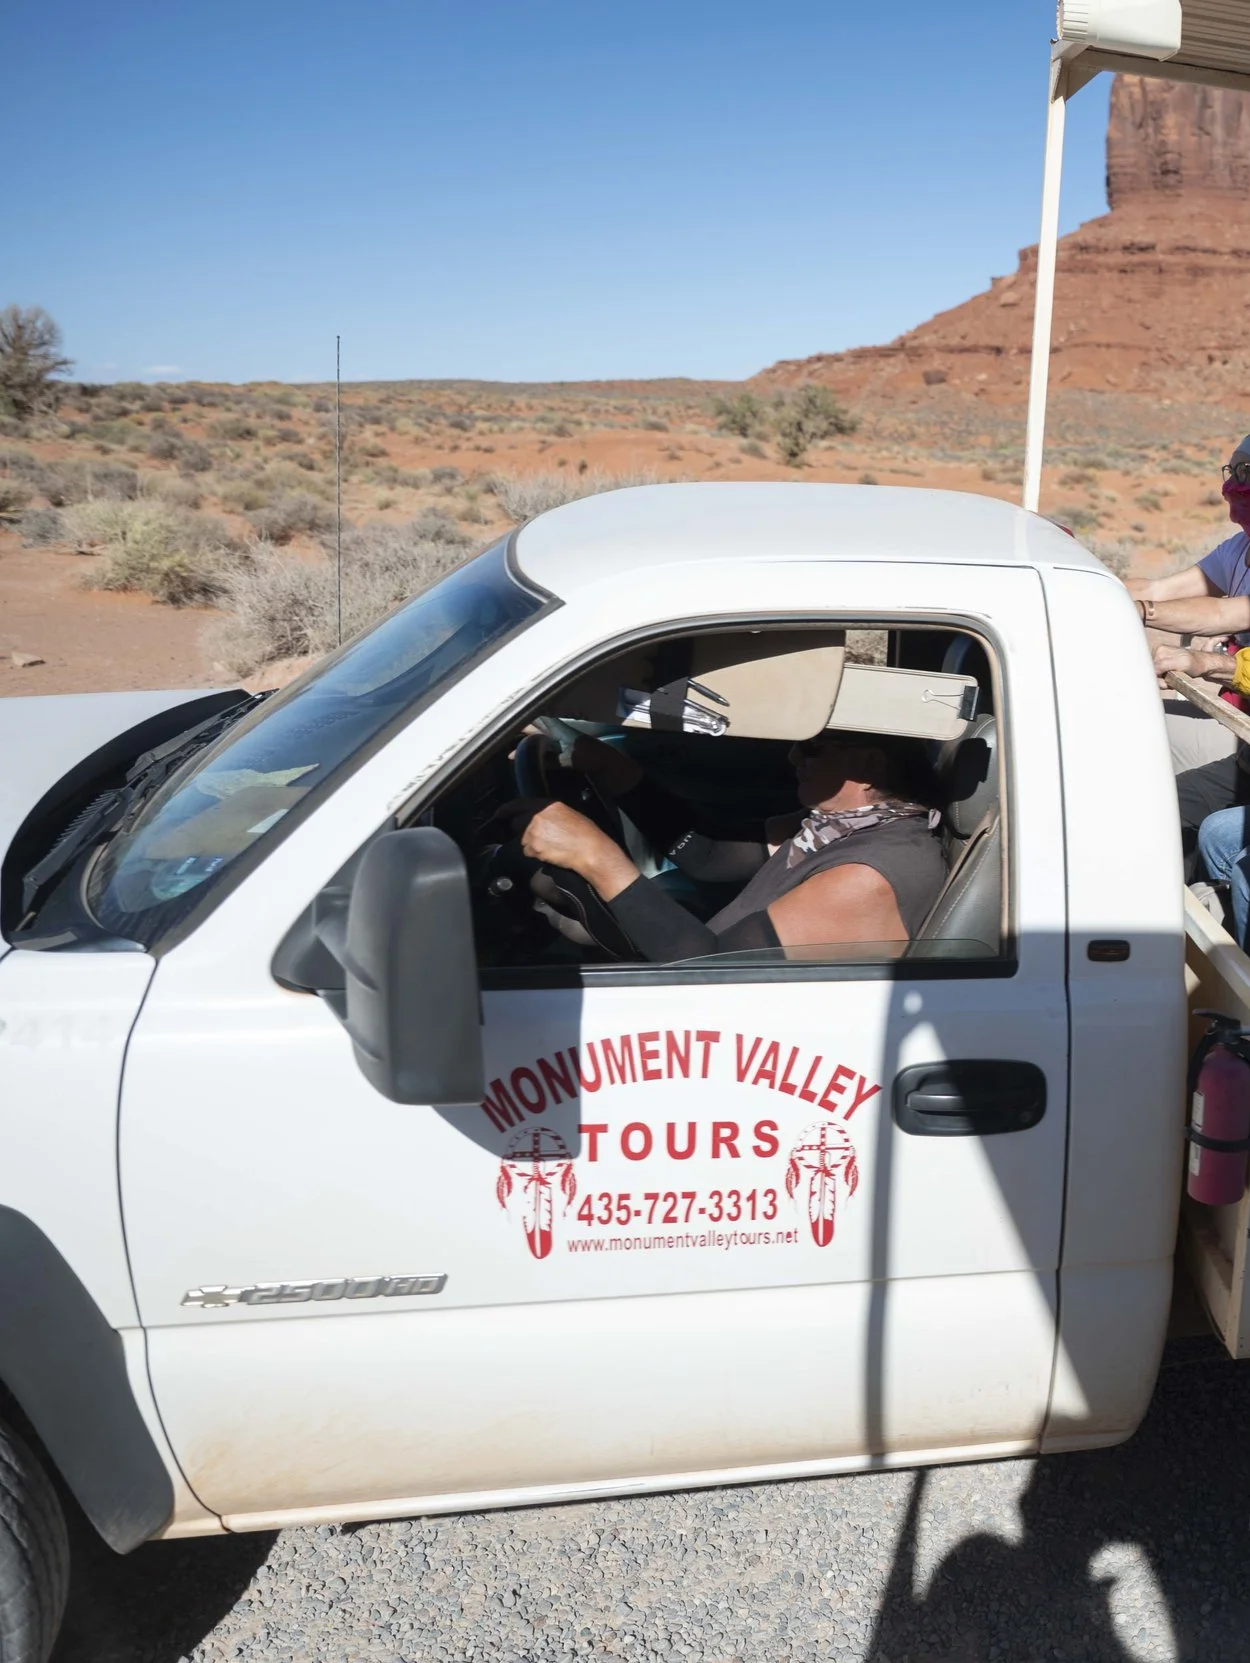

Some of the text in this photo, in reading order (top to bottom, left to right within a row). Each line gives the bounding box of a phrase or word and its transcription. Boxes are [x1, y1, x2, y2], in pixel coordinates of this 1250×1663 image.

[481, 1030, 882, 1133] MONUMENT VALLEY
[578, 1119, 781, 1162] TOURS
[576, 1187, 779, 1227] 435-727-3313
[566, 1228, 799, 1252] www.monumentvalleytours.net
